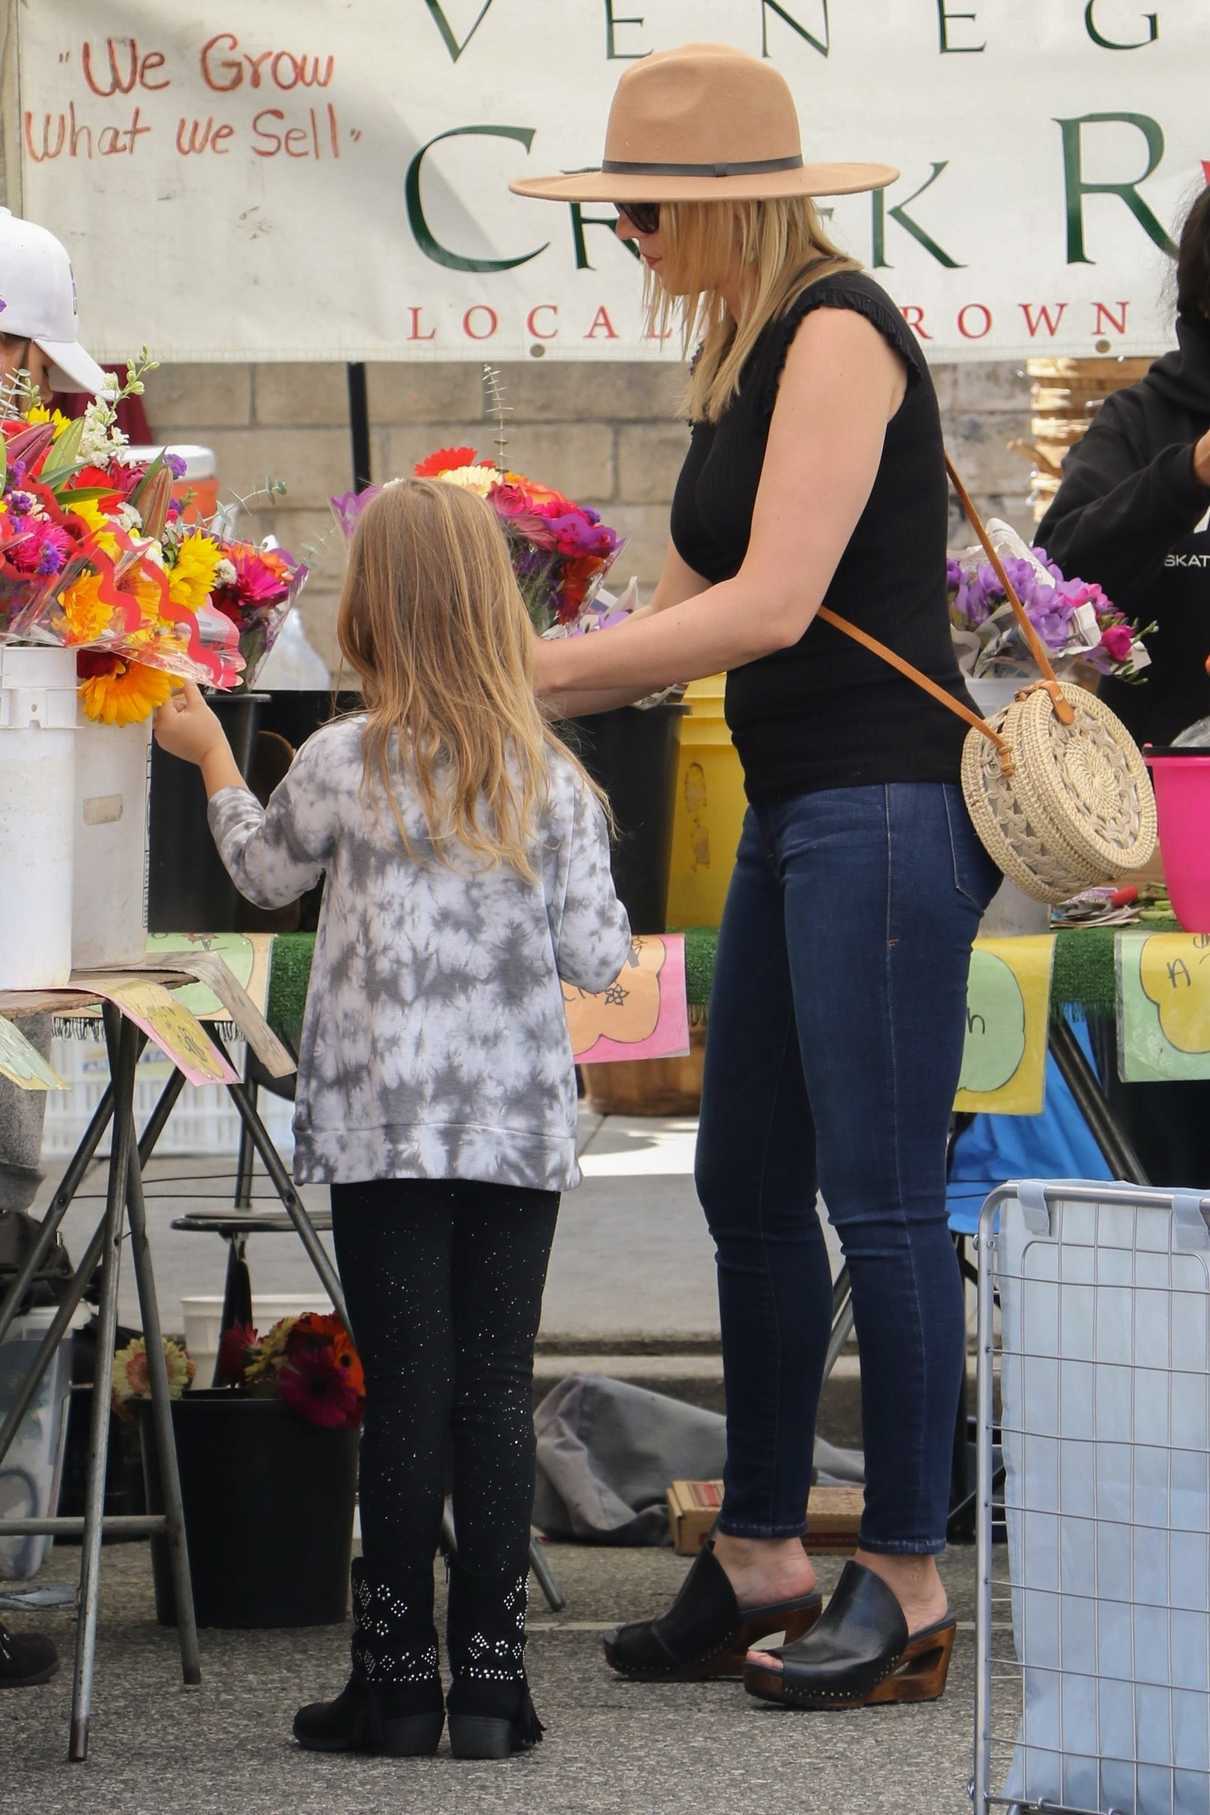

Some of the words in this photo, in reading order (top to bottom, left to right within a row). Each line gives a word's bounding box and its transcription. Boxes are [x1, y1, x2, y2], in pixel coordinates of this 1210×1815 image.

[58, 38, 171, 97] "We
[200, 33, 335, 93] Grow
[23, 101, 152, 162] What
[251, 103, 363, 160] Sell"
[900, 301, 1130, 340] ROWN
